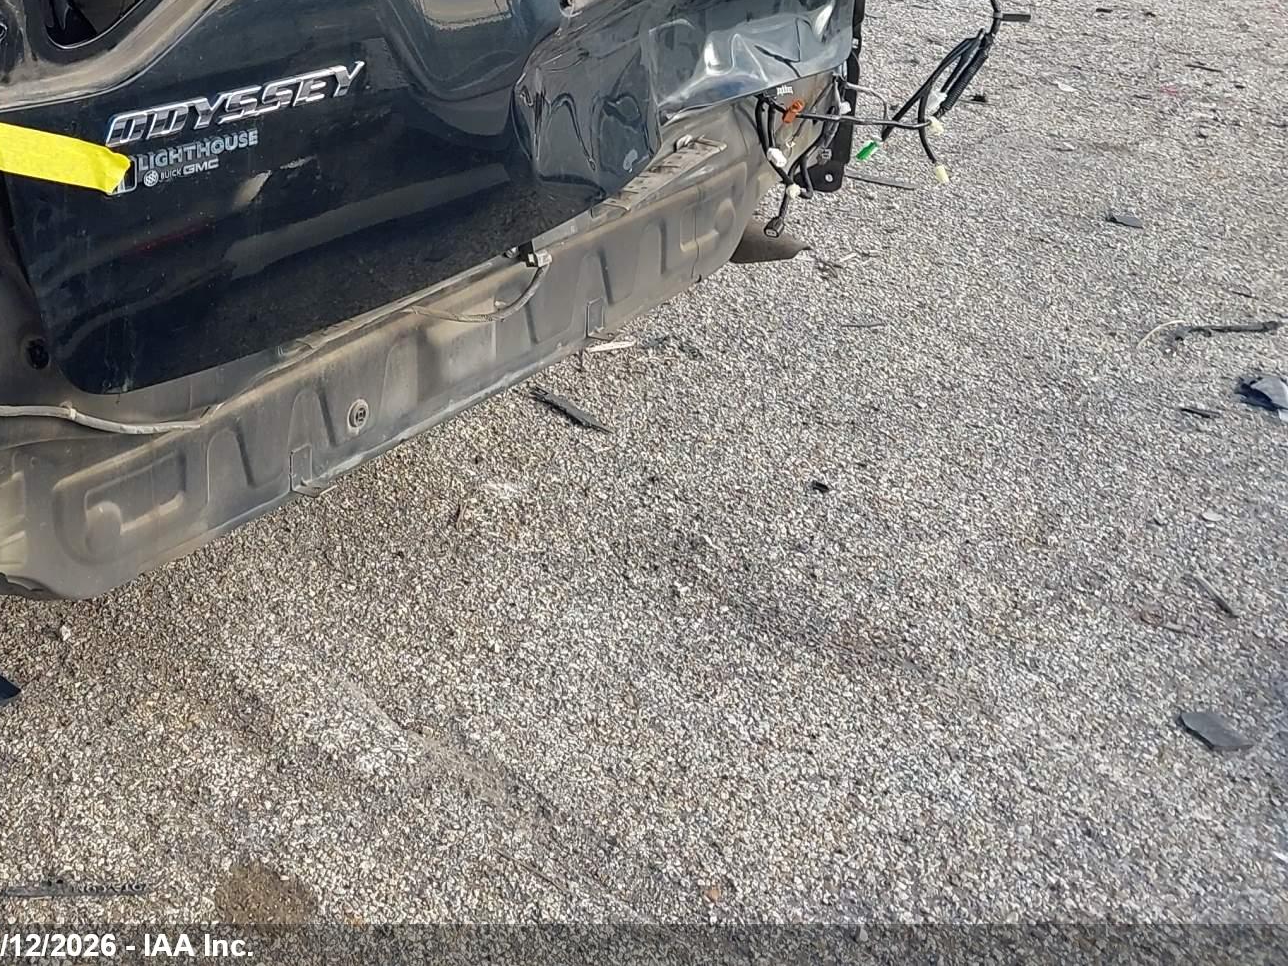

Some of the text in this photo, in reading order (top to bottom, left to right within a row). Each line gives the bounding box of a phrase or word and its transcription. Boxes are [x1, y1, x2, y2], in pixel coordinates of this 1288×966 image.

[106, 61, 366, 147] ODYSSEY
[138, 129, 259, 171] LIGHTHOUSE
[160, 158, 219, 180] BUICK GMC
